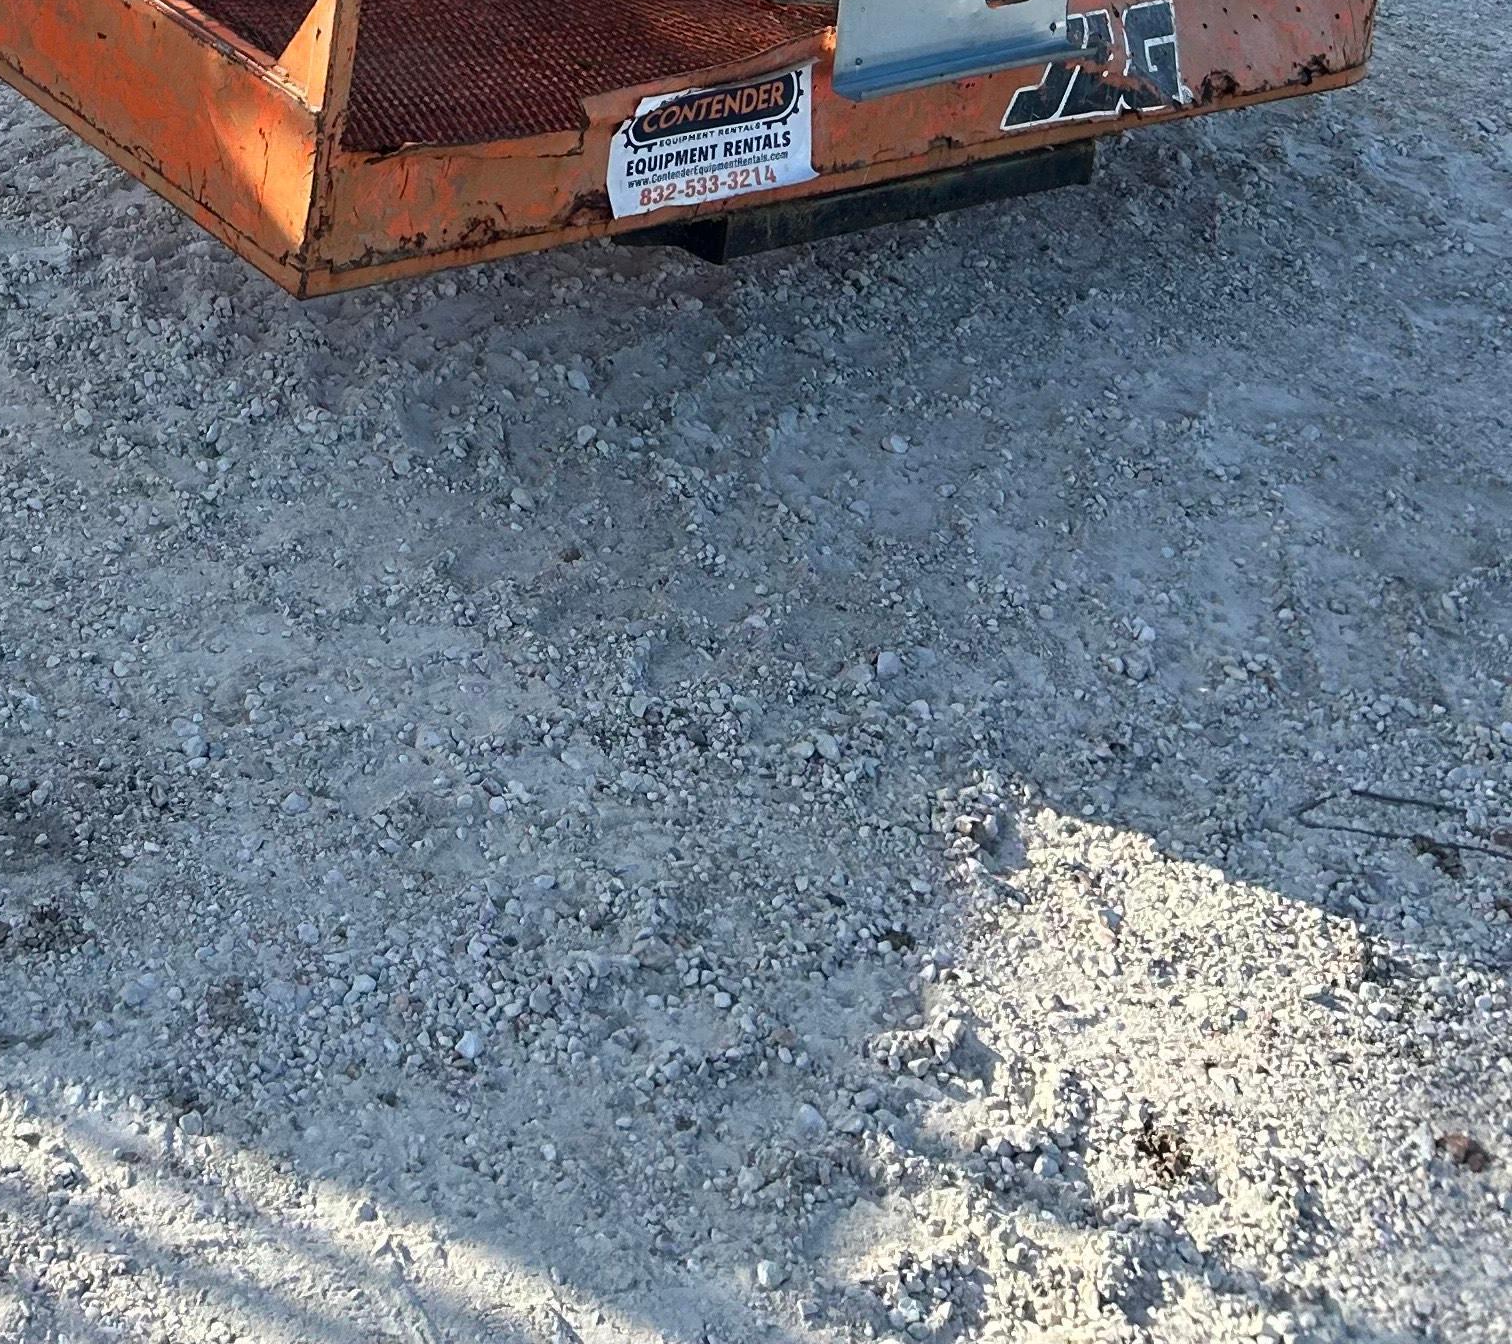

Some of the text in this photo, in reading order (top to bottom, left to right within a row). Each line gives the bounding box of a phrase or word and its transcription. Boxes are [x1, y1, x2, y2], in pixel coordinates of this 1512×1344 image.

[642, 81, 785, 133] CONTENDER
[626, 130, 792, 177] EQUIPMENT RENTALS
[659, 122, 762, 147] EQUIPMENT RENTALS
[627, 150, 789, 189] www.ContenderEquipmentRentals.com
[639, 164, 777, 207] 832-533-3214
